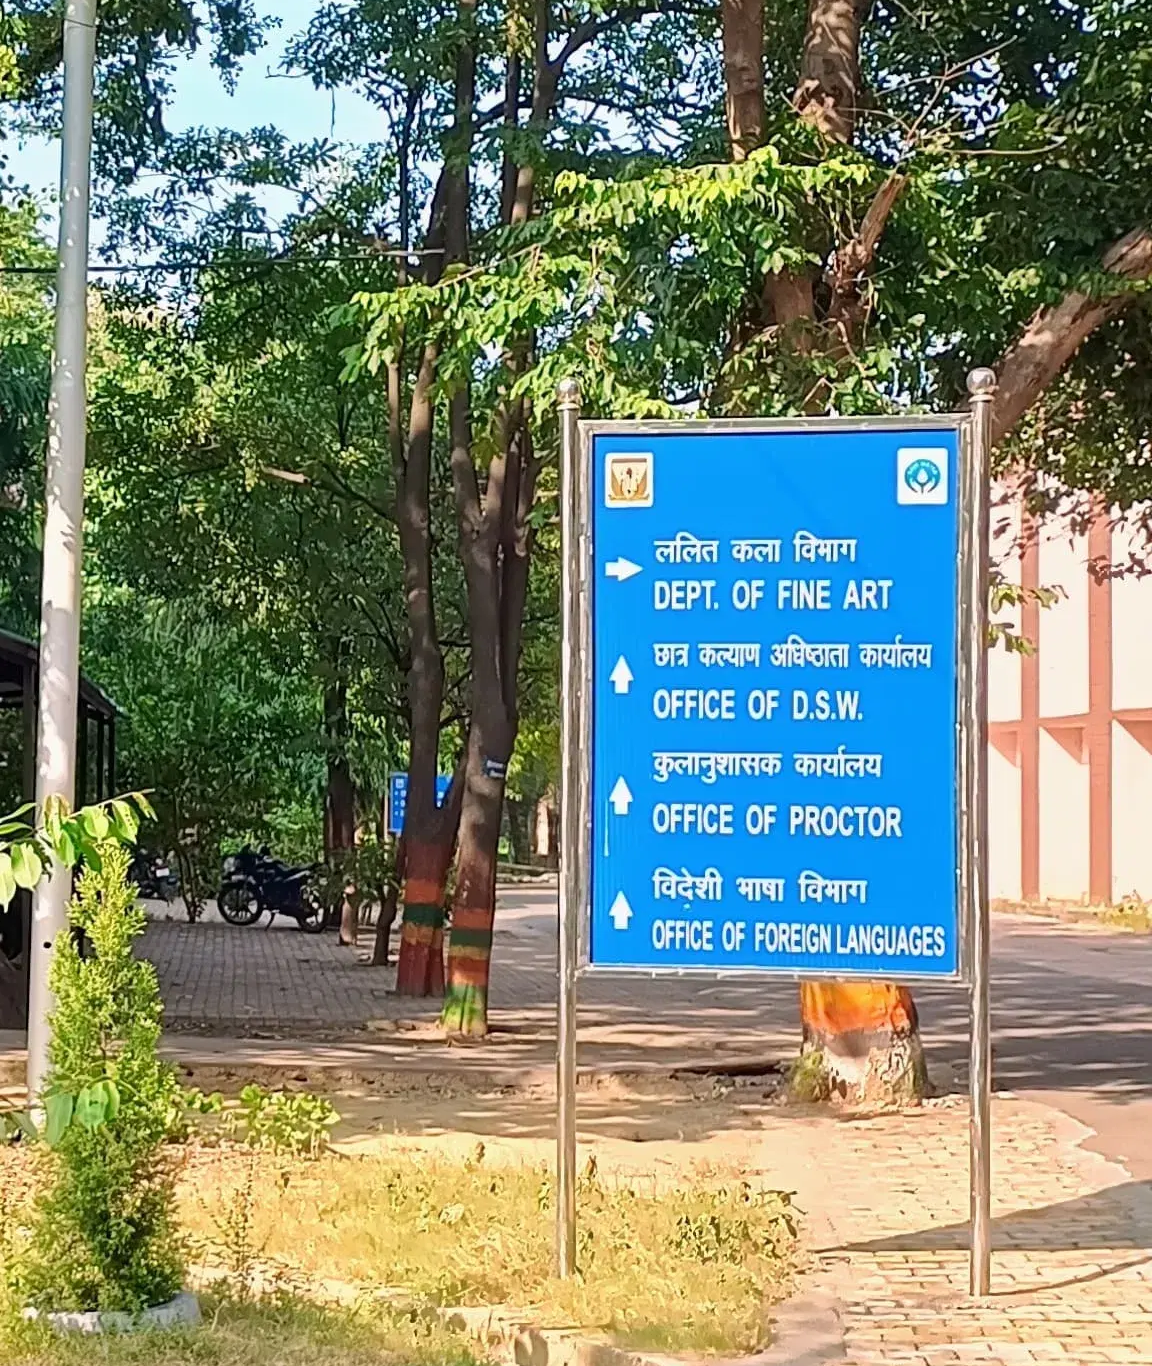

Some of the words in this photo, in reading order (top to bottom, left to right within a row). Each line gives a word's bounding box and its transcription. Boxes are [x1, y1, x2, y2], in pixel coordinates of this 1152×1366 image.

[653, 531, 720, 563] ललित
[730, 539, 782, 563] कला
[793, 530, 857, 563] विभाग
[654, 580, 719, 610] DEPT.
[732, 579, 765, 610] OF
[778, 579, 831, 610] FINE
[843, 579, 893, 610] ART
[653, 643, 690, 667] छात्र
[697, 643, 761, 668] कल्याण
[858, 634, 933, 668] कार्यालय
[653, 689, 736, 720] OFFICE
[747, 689, 780, 720] OF
[792, 689, 863, 721] D.S.W.
[652, 752, 782, 784] कुलानुशासक
[793, 745, 883, 777] कार्यालय
[652, 802, 734, 834] OFFICE
[745, 804, 777, 835] OF
[790, 805, 902, 837] PROCTOR
[652, 867, 723, 901] विदेशी
[735, 877, 785, 902] भाषा
[797, 870, 868, 904] विभाग
[652, 919, 714, 951] OFFICE
[722, 921, 746, 951] OF
[754, 922, 832, 954] FOREIGN
[836, 924, 946, 957] LANGUAGES
